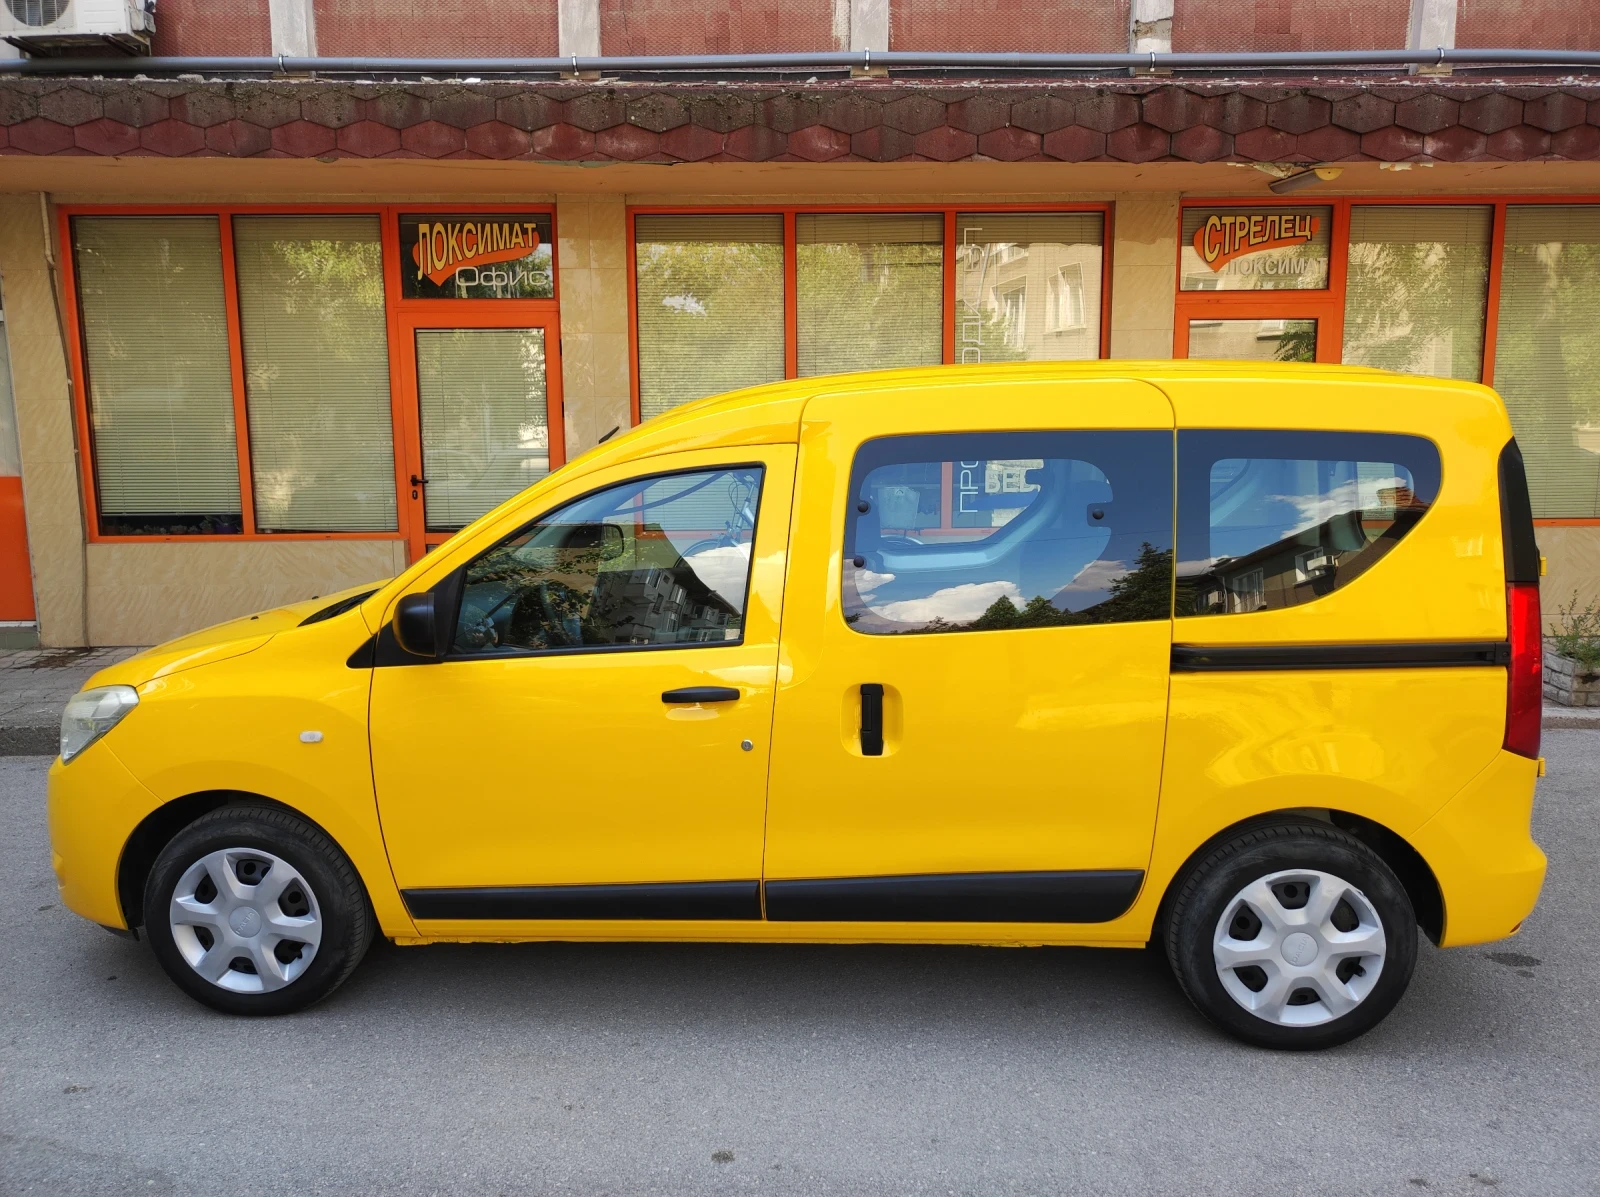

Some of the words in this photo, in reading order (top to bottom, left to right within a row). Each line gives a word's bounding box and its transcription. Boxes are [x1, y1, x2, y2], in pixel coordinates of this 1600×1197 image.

[417, 222, 537, 281] ЛОКСИМАТ
[1203, 214, 1312, 263] СТРЕЛЕЦ
[455, 266, 547, 290] Офис
[1227, 257, 1328, 276] ЛОКСИМАТ
